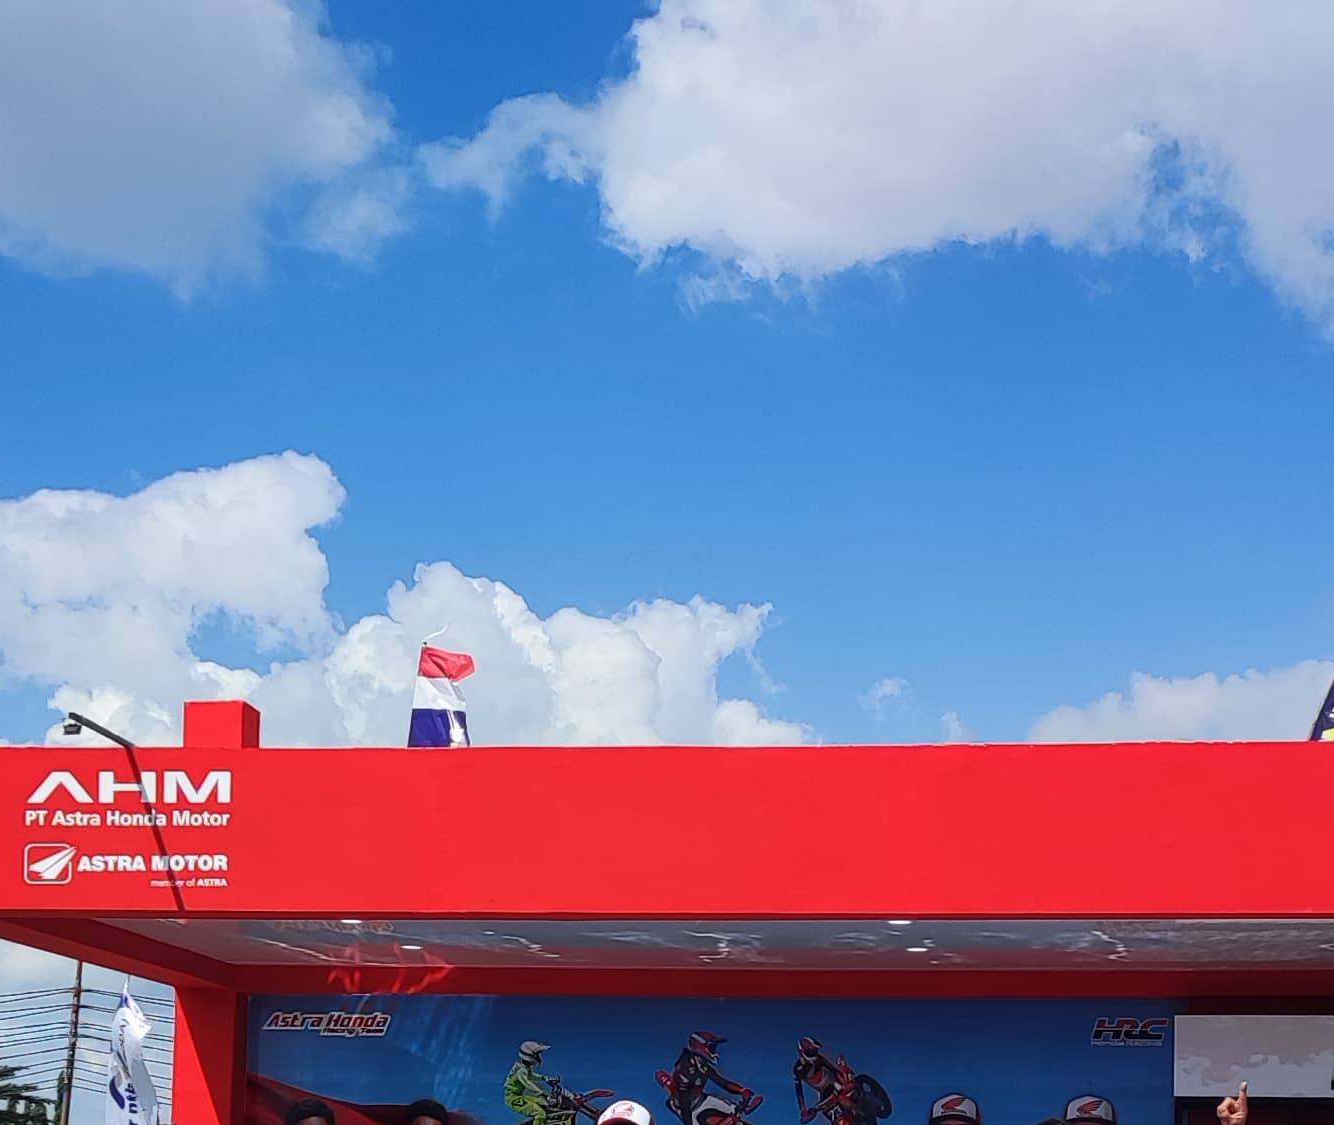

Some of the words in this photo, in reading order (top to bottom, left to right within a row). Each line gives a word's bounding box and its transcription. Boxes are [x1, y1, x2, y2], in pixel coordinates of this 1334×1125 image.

[26, 771, 232, 804] AHM
[24, 810, 48, 826] PT
[51, 810, 101, 826] Astra
[106, 809, 167, 826] Honda
[172, 810, 231, 826] Motor
[77, 856, 147, 872] ASTRA
[151, 855, 228, 871] MOTOR
[186, 879, 196, 887] of
[197, 879, 228, 887] ASTRA
[267, 1011, 325, 1028] Astra
[326, 1011, 390, 1028] Honda
